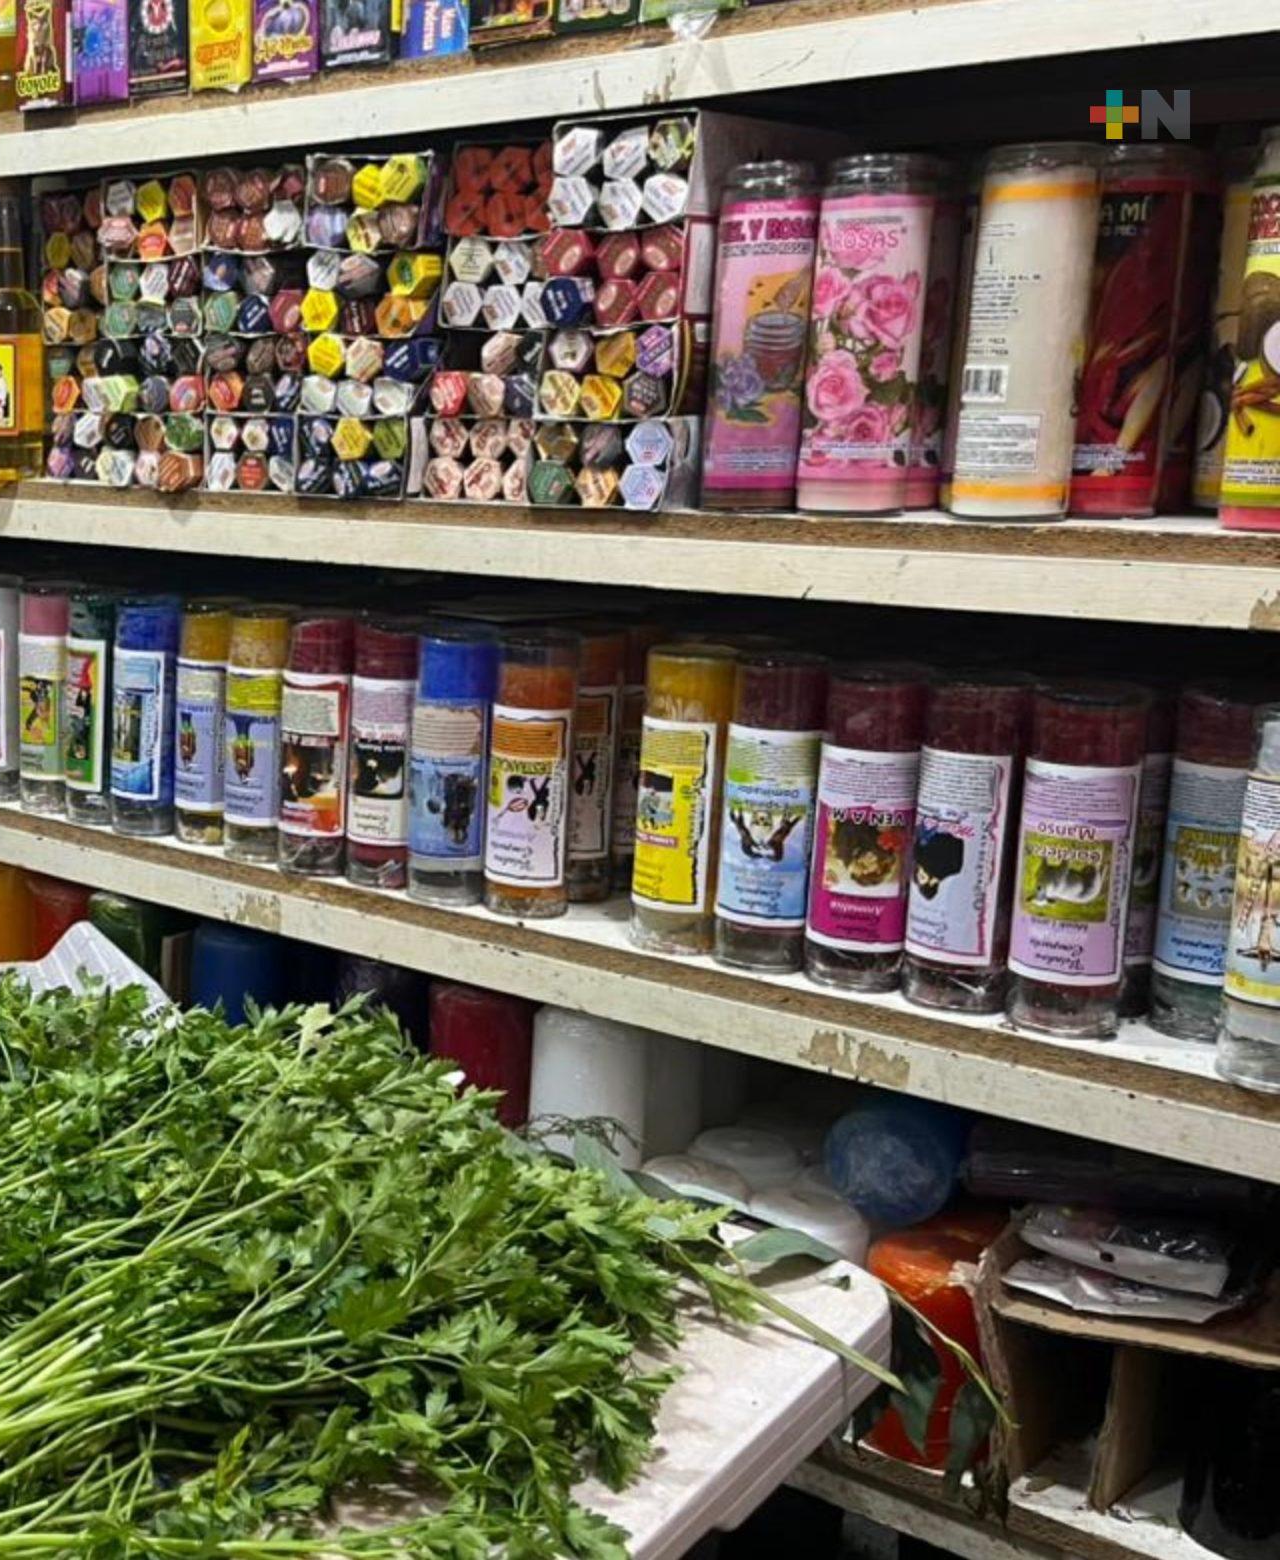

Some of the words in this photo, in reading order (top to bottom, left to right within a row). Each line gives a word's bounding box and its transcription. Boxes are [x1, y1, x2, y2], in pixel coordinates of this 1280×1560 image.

[16, 72, 61, 98] Coyote
[851, 810, 867, 825] A
[869, 811, 905, 827] VEN
[1038, 822, 1096, 841] Manso
